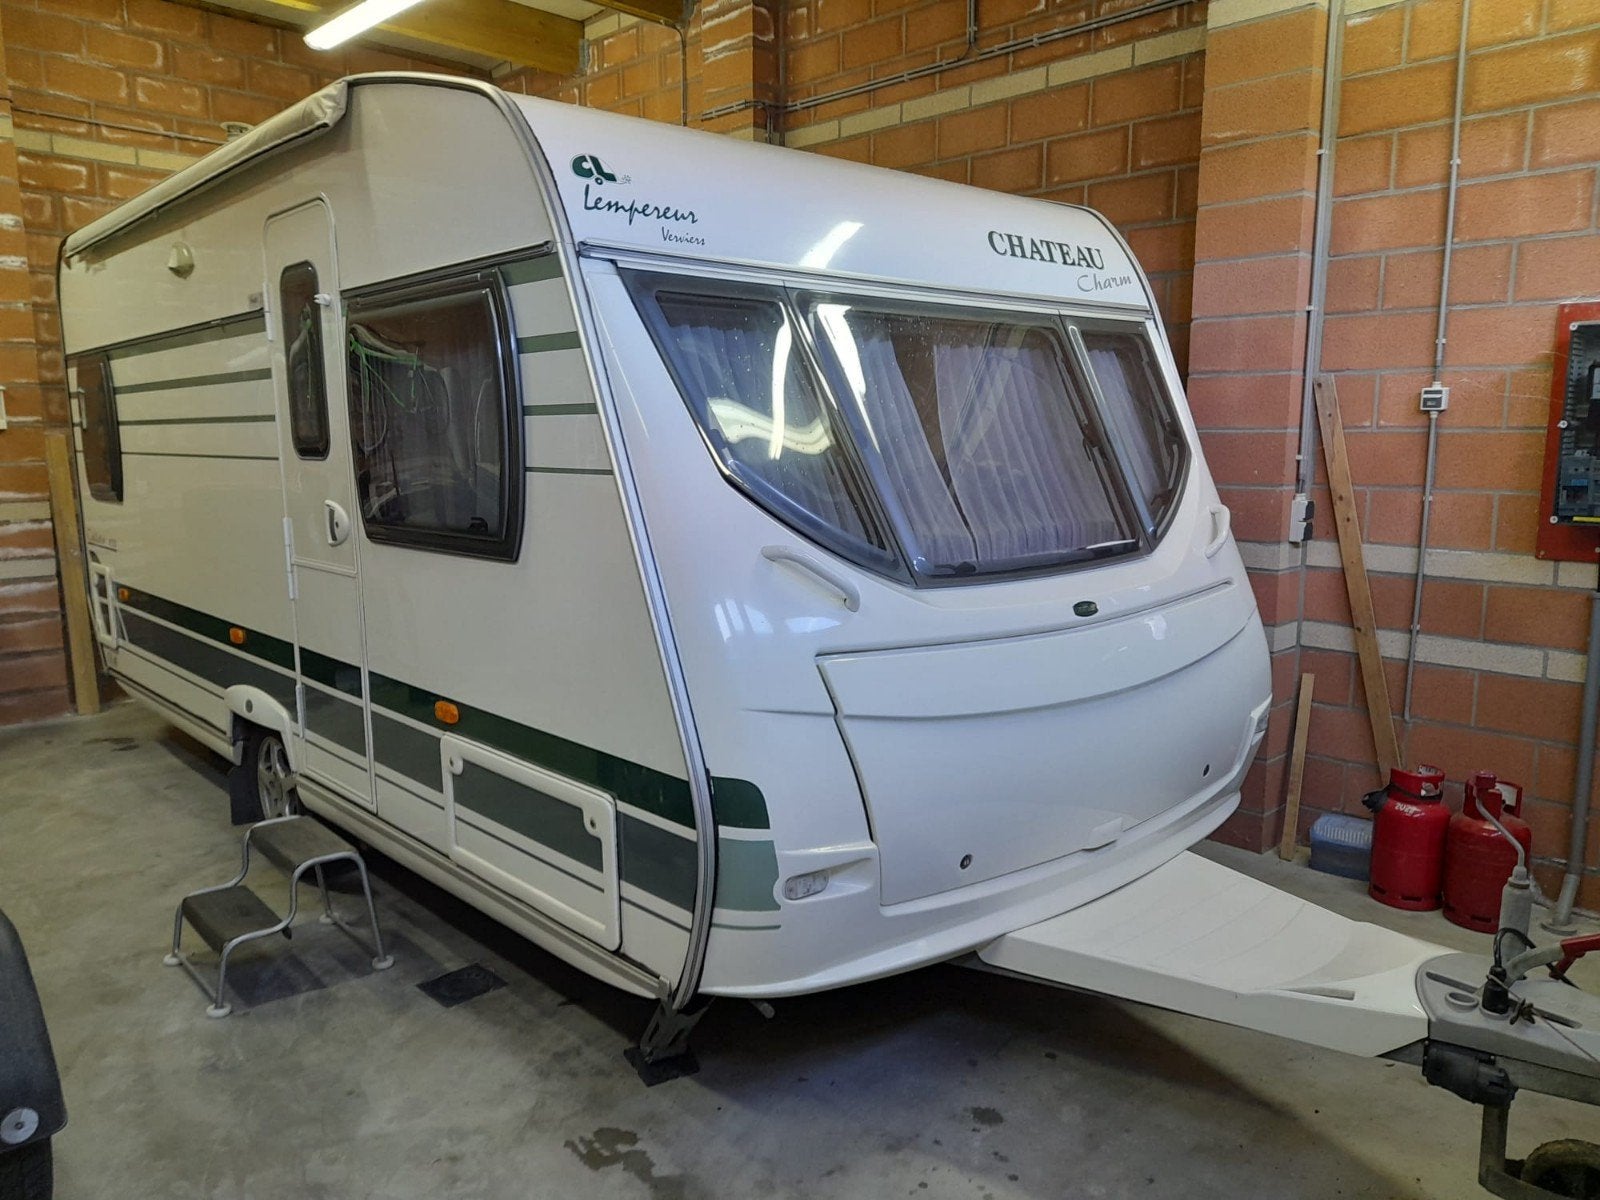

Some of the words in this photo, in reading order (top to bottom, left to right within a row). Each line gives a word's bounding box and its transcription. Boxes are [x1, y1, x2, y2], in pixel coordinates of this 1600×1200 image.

[583, 183, 699, 226] Lempereur
[661, 226, 706, 246] Verviers
[987, 230, 1105, 270] CHATEAU
[1076, 273, 1132, 293] Charm
